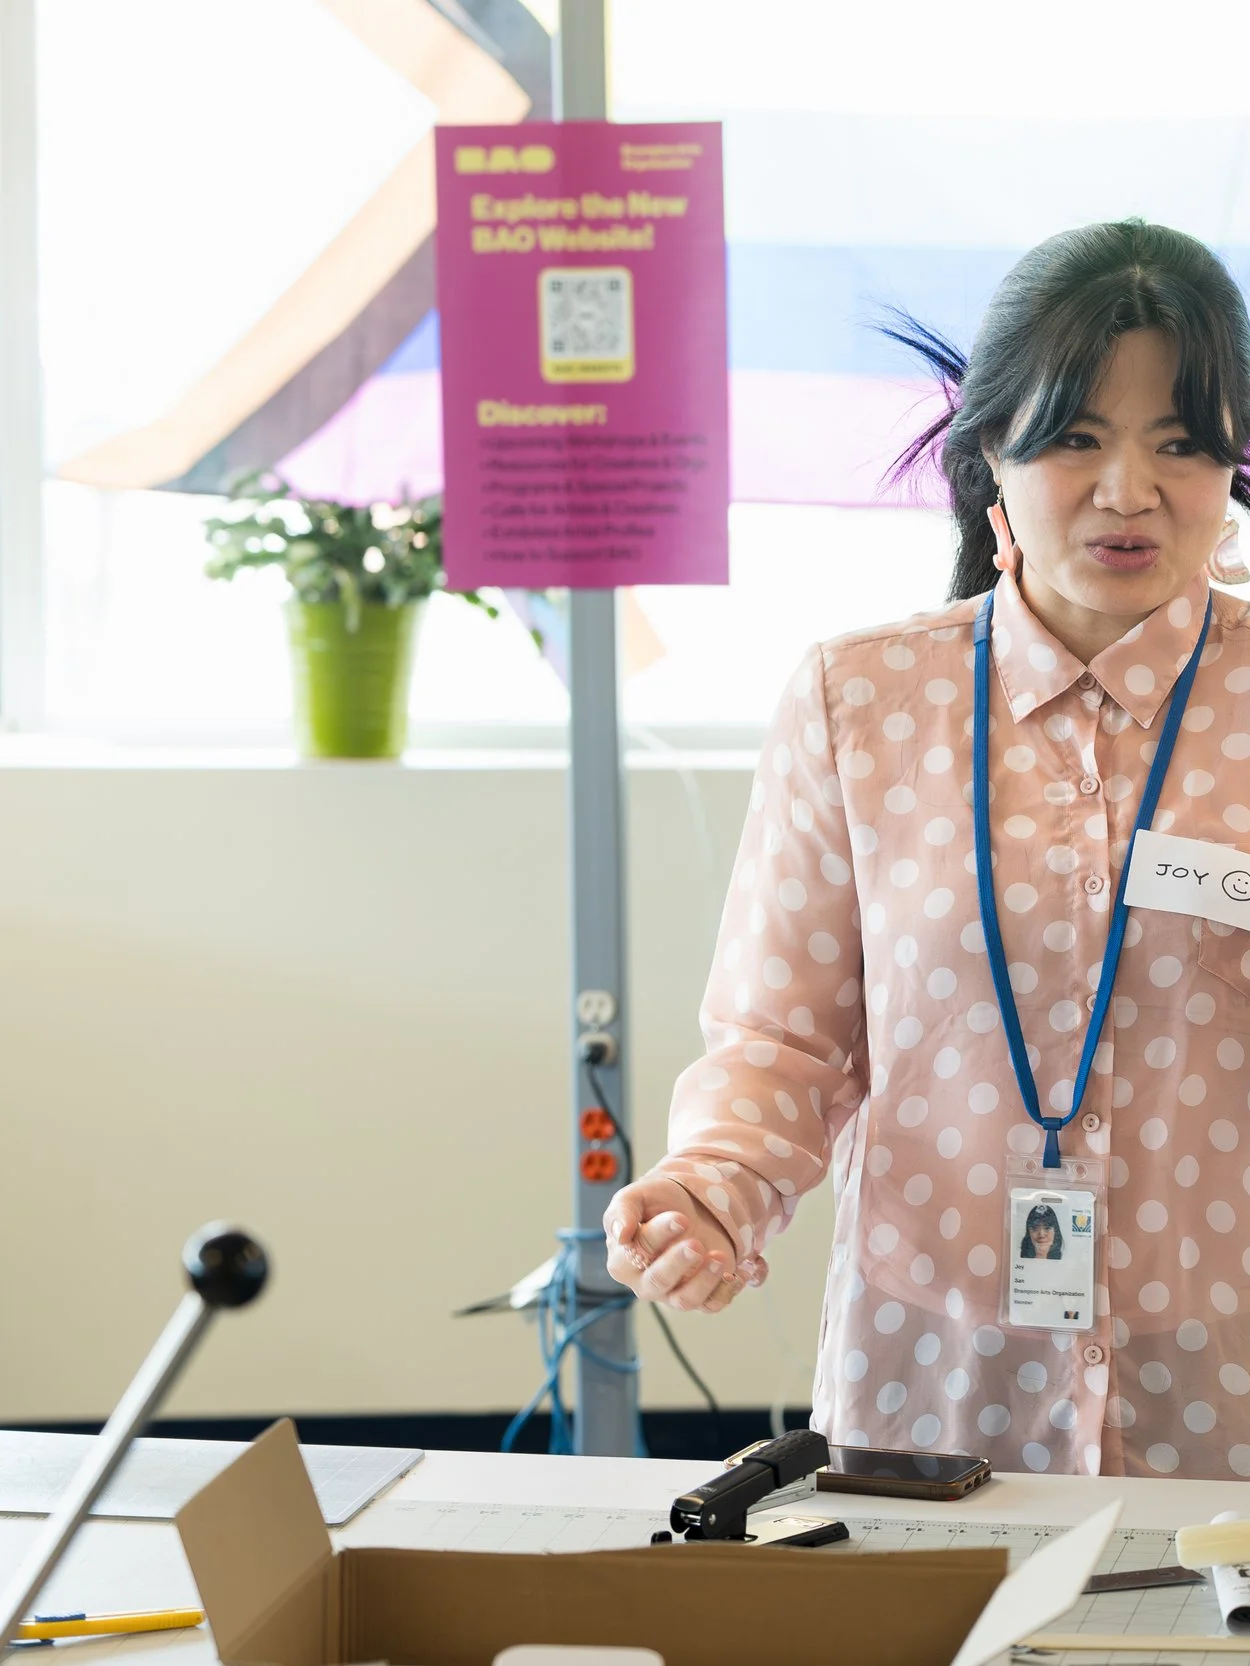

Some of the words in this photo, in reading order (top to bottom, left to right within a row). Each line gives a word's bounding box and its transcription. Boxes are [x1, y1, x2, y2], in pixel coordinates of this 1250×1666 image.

[471, 193, 578, 223] Explore
[580, 192, 625, 219] the
[627, 191, 689, 218] New
[472, 226, 536, 253] BAO
[537, 223, 655, 252] Website!
[477, 399, 607, 427] Discover:
[1155, 863, 1210, 886] JOY
